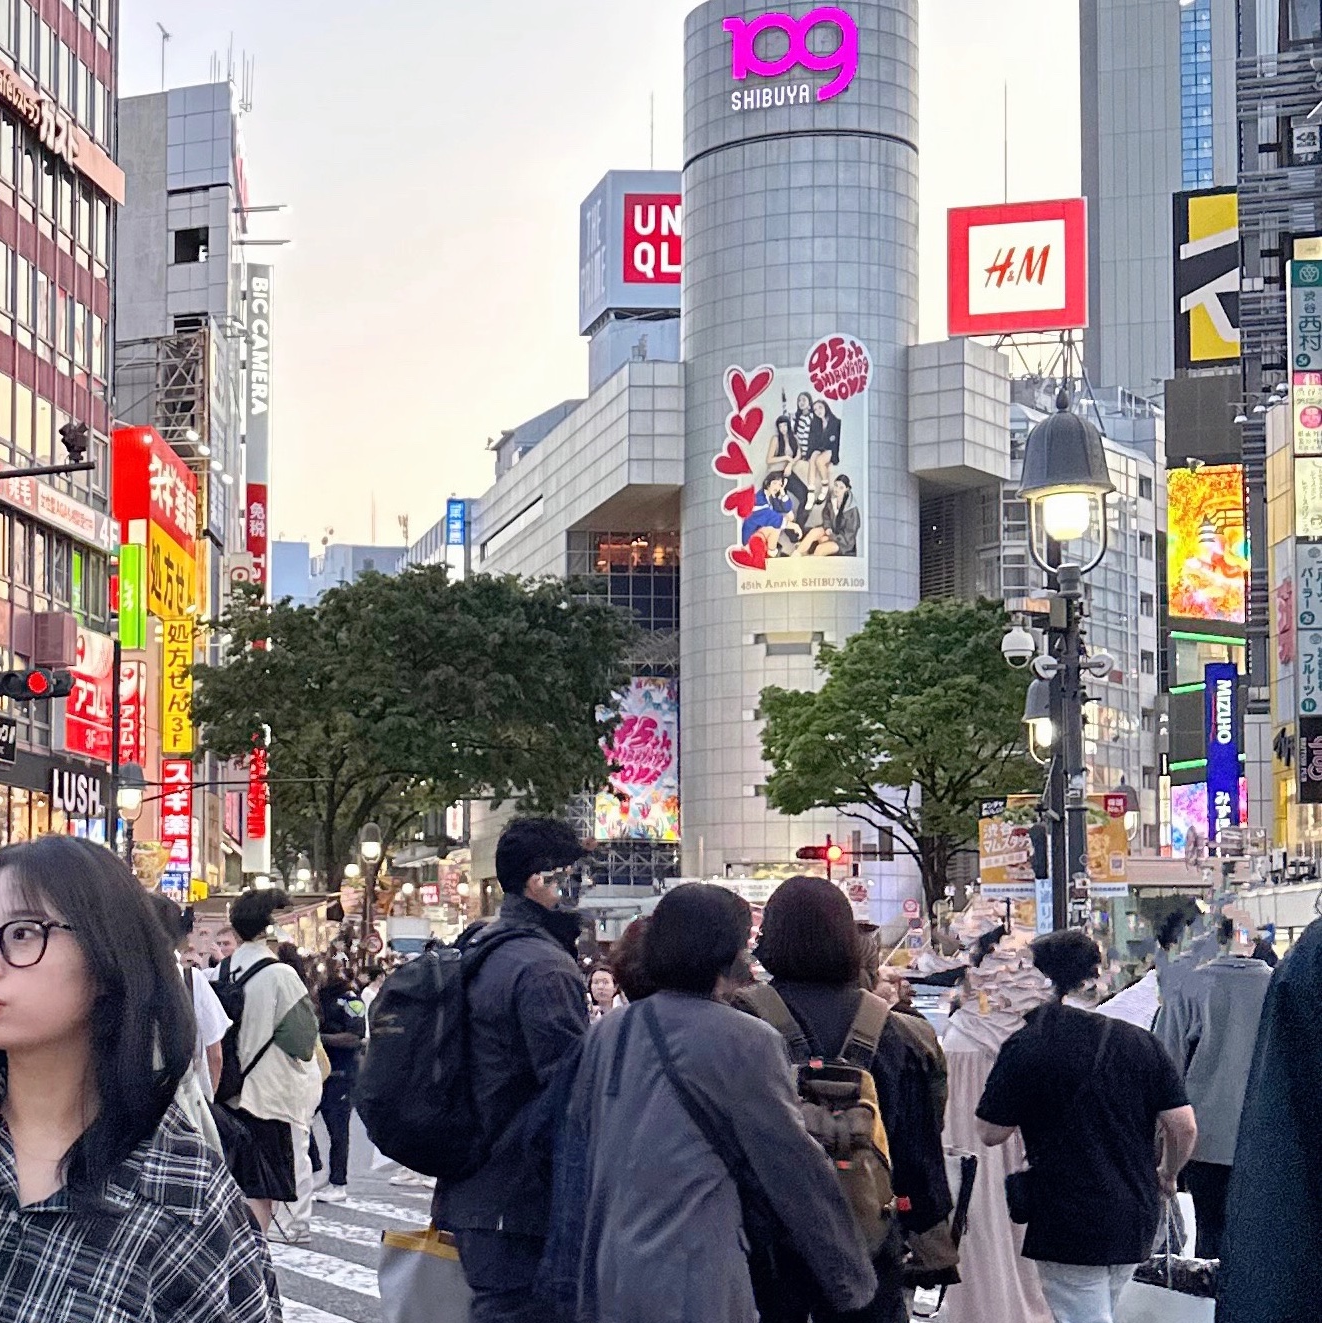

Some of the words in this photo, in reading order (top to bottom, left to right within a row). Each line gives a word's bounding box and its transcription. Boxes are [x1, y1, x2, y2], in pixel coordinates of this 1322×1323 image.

[722, 6, 859, 102] 109
[731, 84, 810, 111] SHIBUYA
[633, 204, 682, 236] UN
[633, 241, 682, 279] QL
[984, 243, 1051, 288] H&M
[251, 276, 269, 314] BIC
[251, 318, 269, 416] CAMERA
[808, 337, 863, 373] 45th
[249, 502, 266, 538] 免税
[1301, 567, 1314, 610] パーラー
[167, 623, 190, 713] 処方せん
[1302, 653, 1315, 696] フルーツ
[74, 679, 108, 719] アコム
[1216, 679, 1232, 744] MIZUHO
[120, 704, 137, 746] アコム
[53, 768, 101, 816] LUSH
